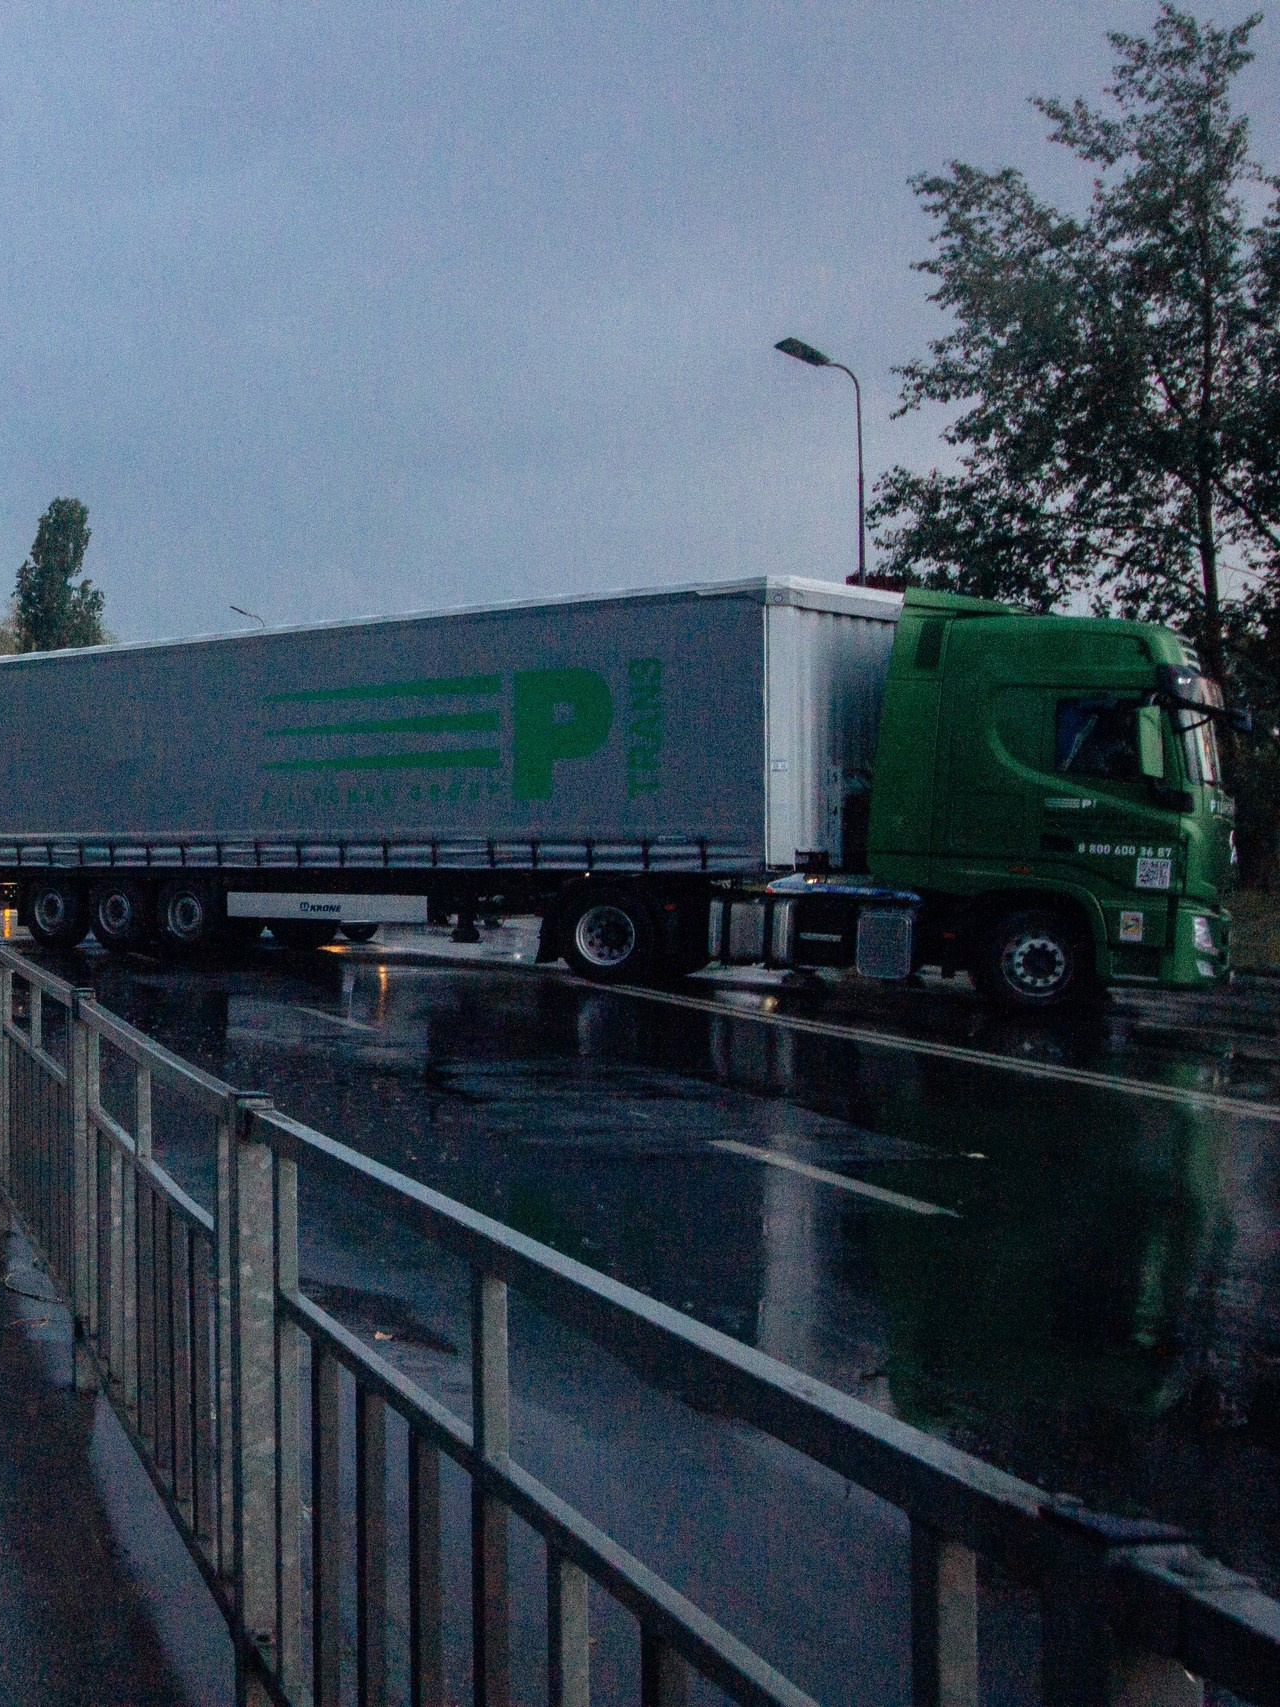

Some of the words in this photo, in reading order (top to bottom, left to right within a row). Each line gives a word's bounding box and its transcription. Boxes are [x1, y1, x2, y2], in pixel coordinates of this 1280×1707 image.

[513, 667, 612, 800] P
[628, 657, 663, 800] TRANS
[1089, 844, 1111, 855] 800
[1114, 845, 1136, 856] 600
[310, 904, 342, 912] KRONE
